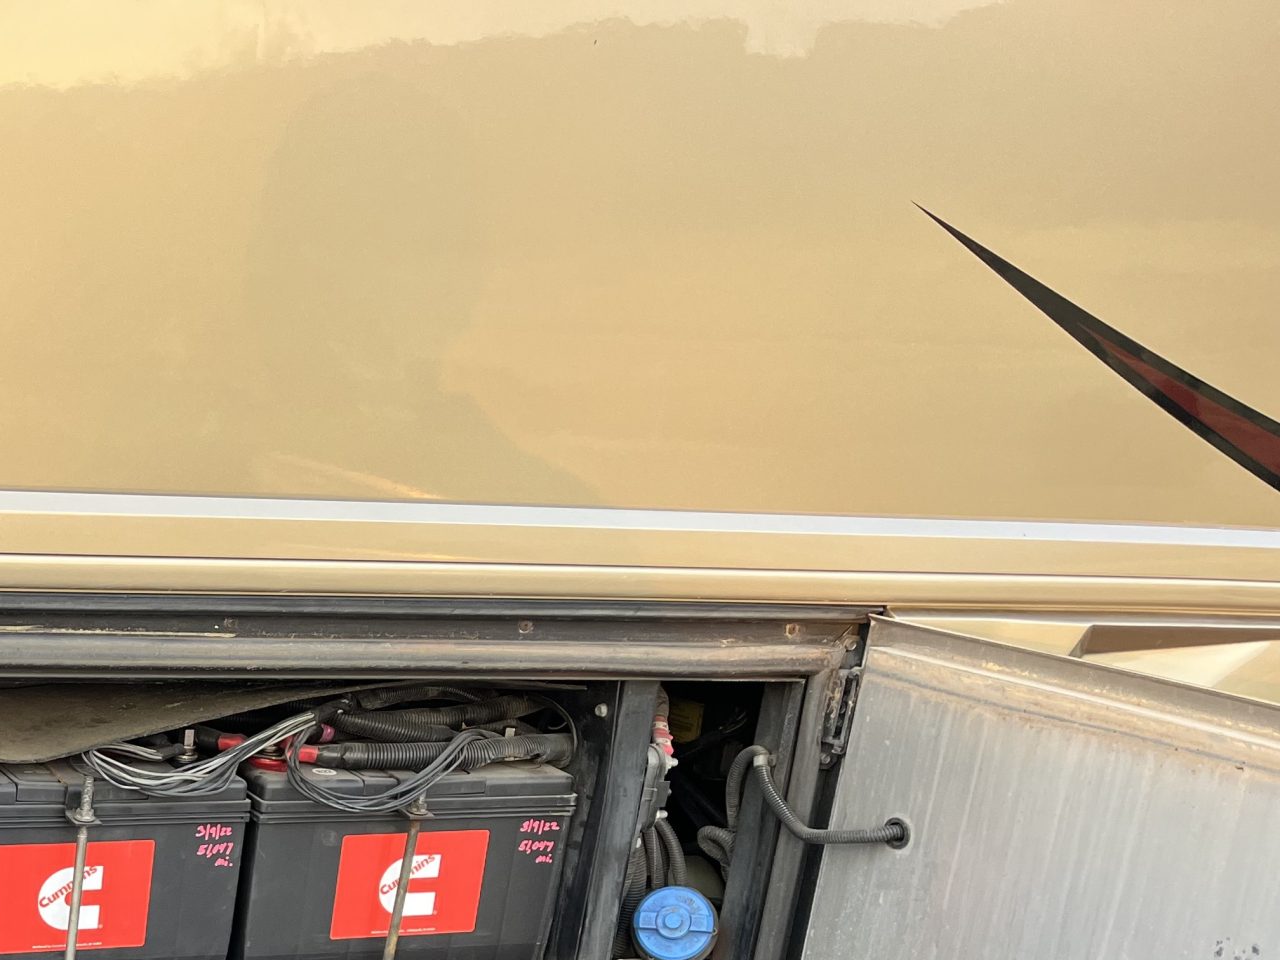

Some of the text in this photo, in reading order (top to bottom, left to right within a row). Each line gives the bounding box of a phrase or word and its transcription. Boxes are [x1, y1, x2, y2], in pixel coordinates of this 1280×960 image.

[195, 823, 233, 841] 3/9/22
[520, 818, 561, 836] 3/9/22
[518, 839, 556, 855] 51,047
[39, 865, 98, 908] Cummns
